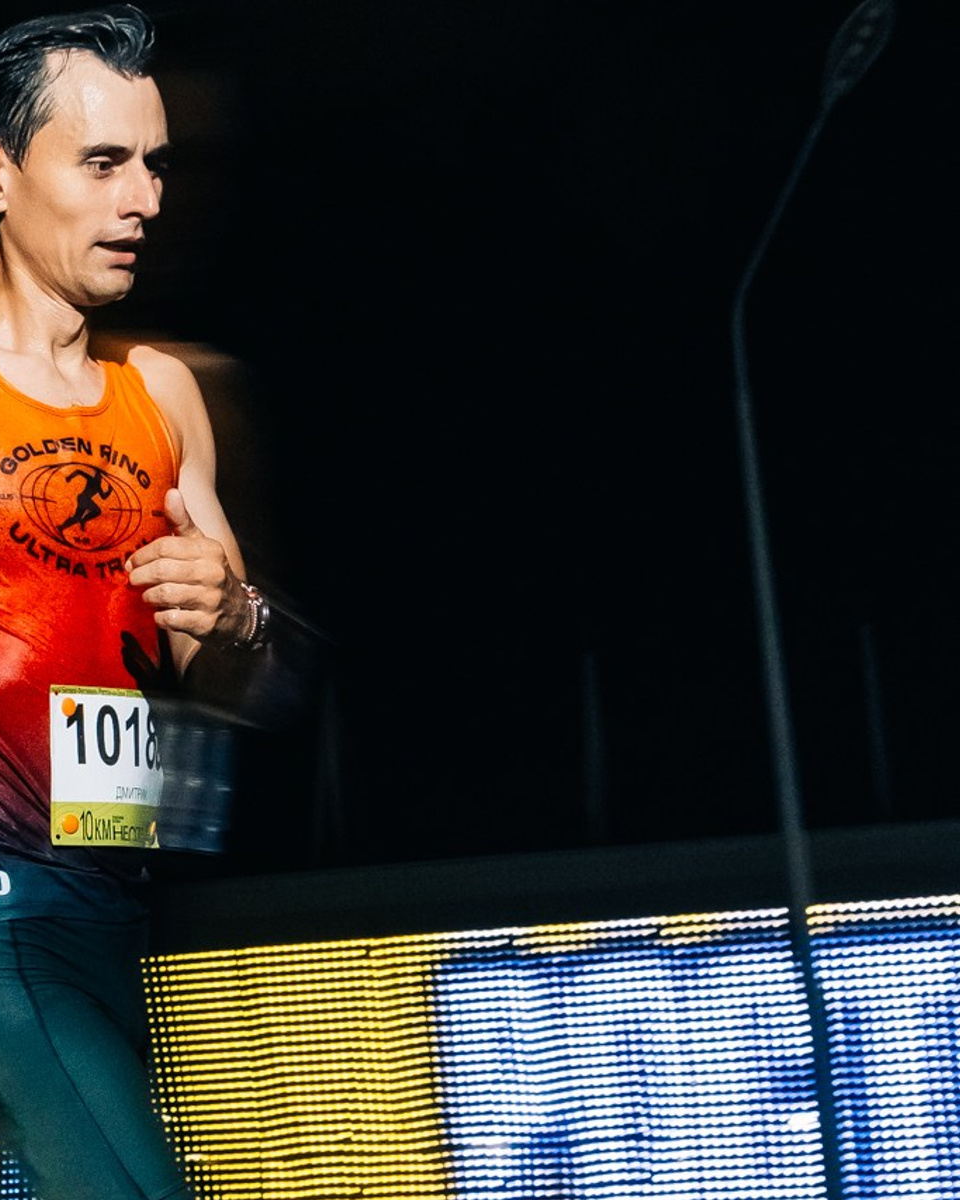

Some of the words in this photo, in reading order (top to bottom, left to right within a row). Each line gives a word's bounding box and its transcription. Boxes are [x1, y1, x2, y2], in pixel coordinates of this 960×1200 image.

[0, 437, 93, 475] GOLDEN
[99, 444, 151, 490] RING
[9, 521, 89, 579] ULTRA
[115, 786, 147, 800] ДМИТРИ
[80, 810, 93, 841] 10
